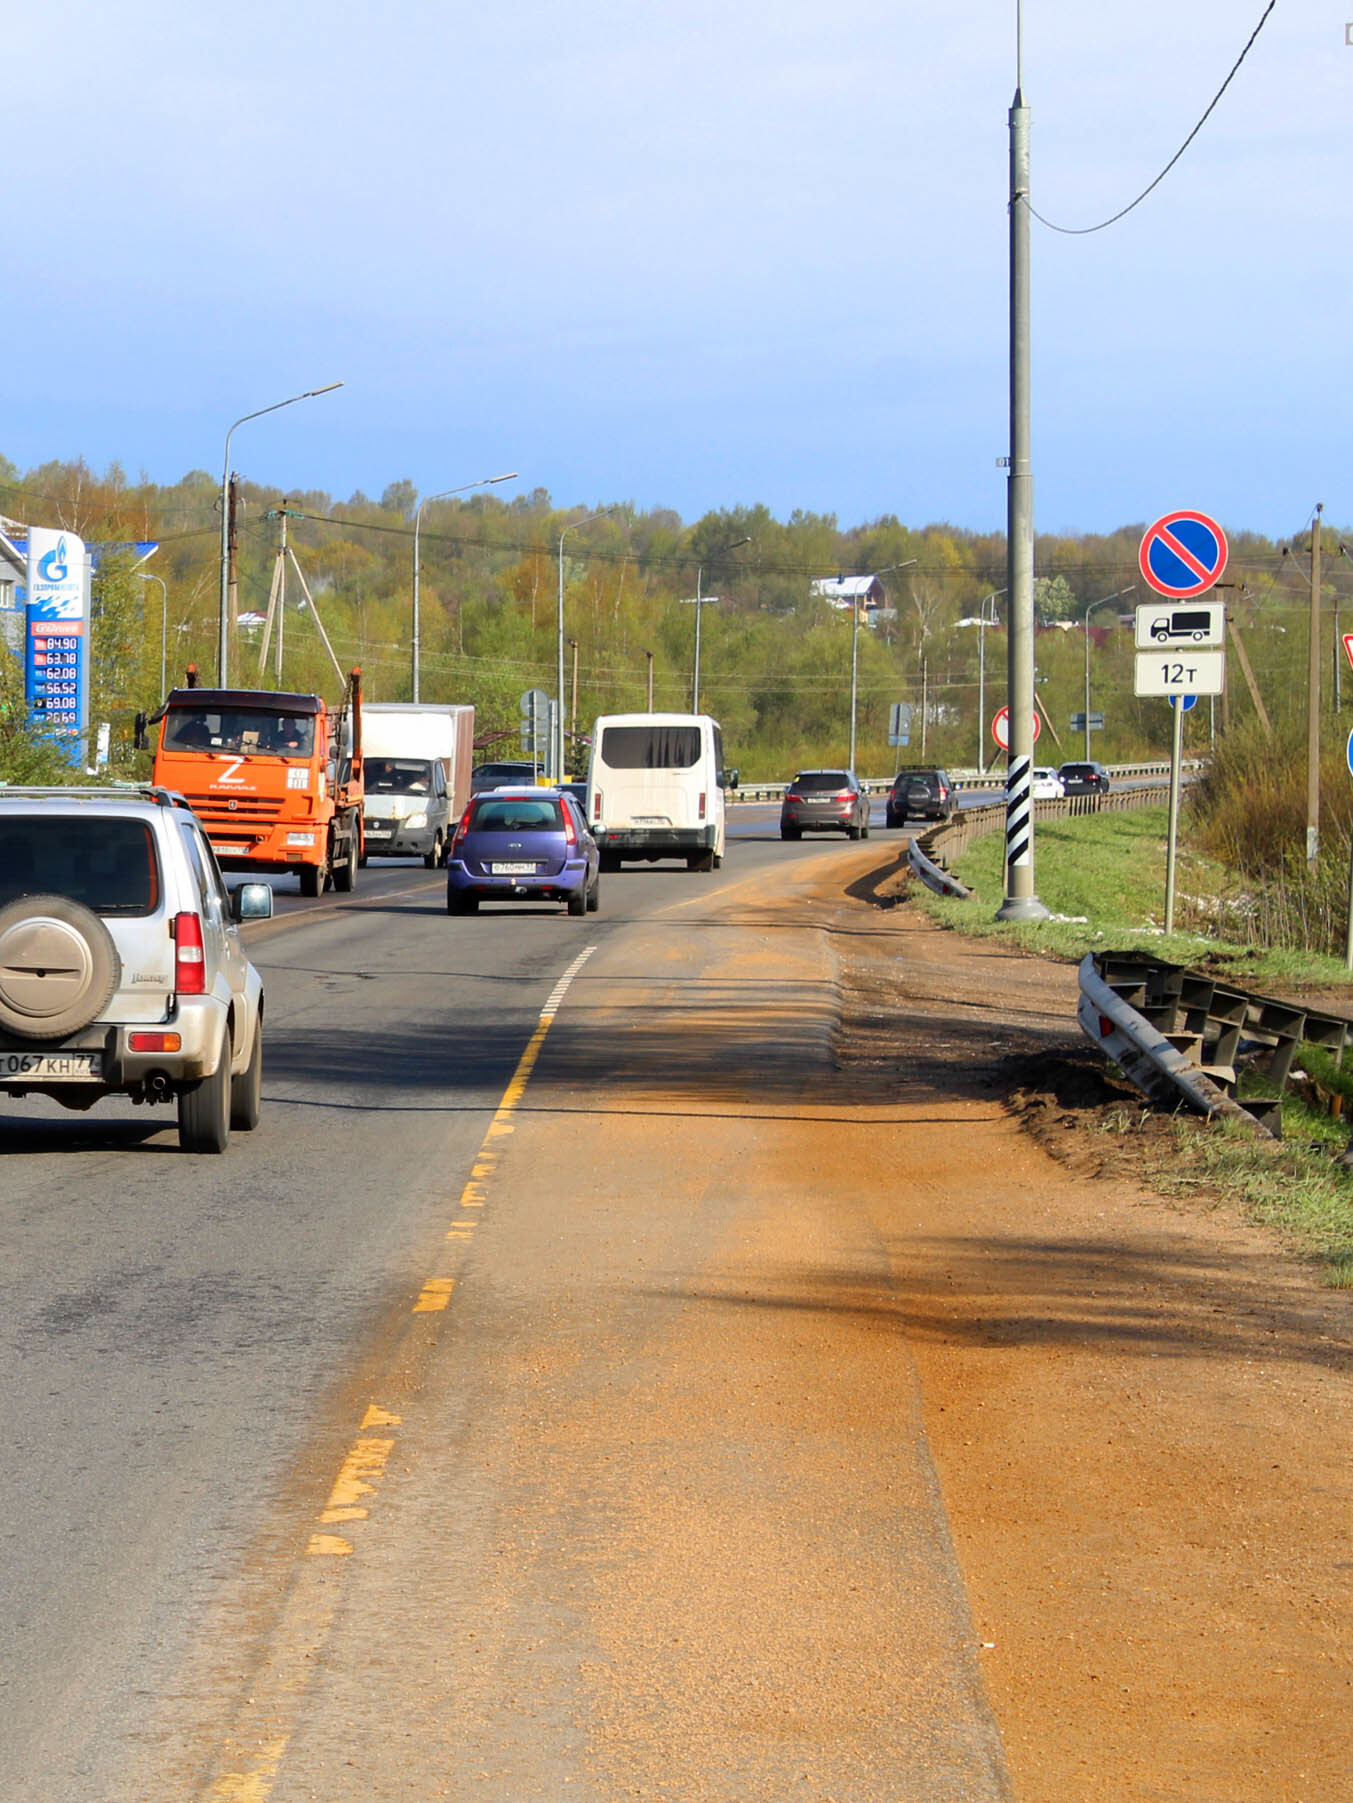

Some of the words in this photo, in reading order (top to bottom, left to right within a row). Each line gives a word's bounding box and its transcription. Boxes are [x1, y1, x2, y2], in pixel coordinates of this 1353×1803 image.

[47, 638, 77, 650] 84.90
[46, 653, 77, 665] 63.78
[46, 667, 77, 679] 62.08
[46, 682, 76, 694] 56.52
[46, 697, 76, 709] 69.08
[218, 755, 246, 783] Z
